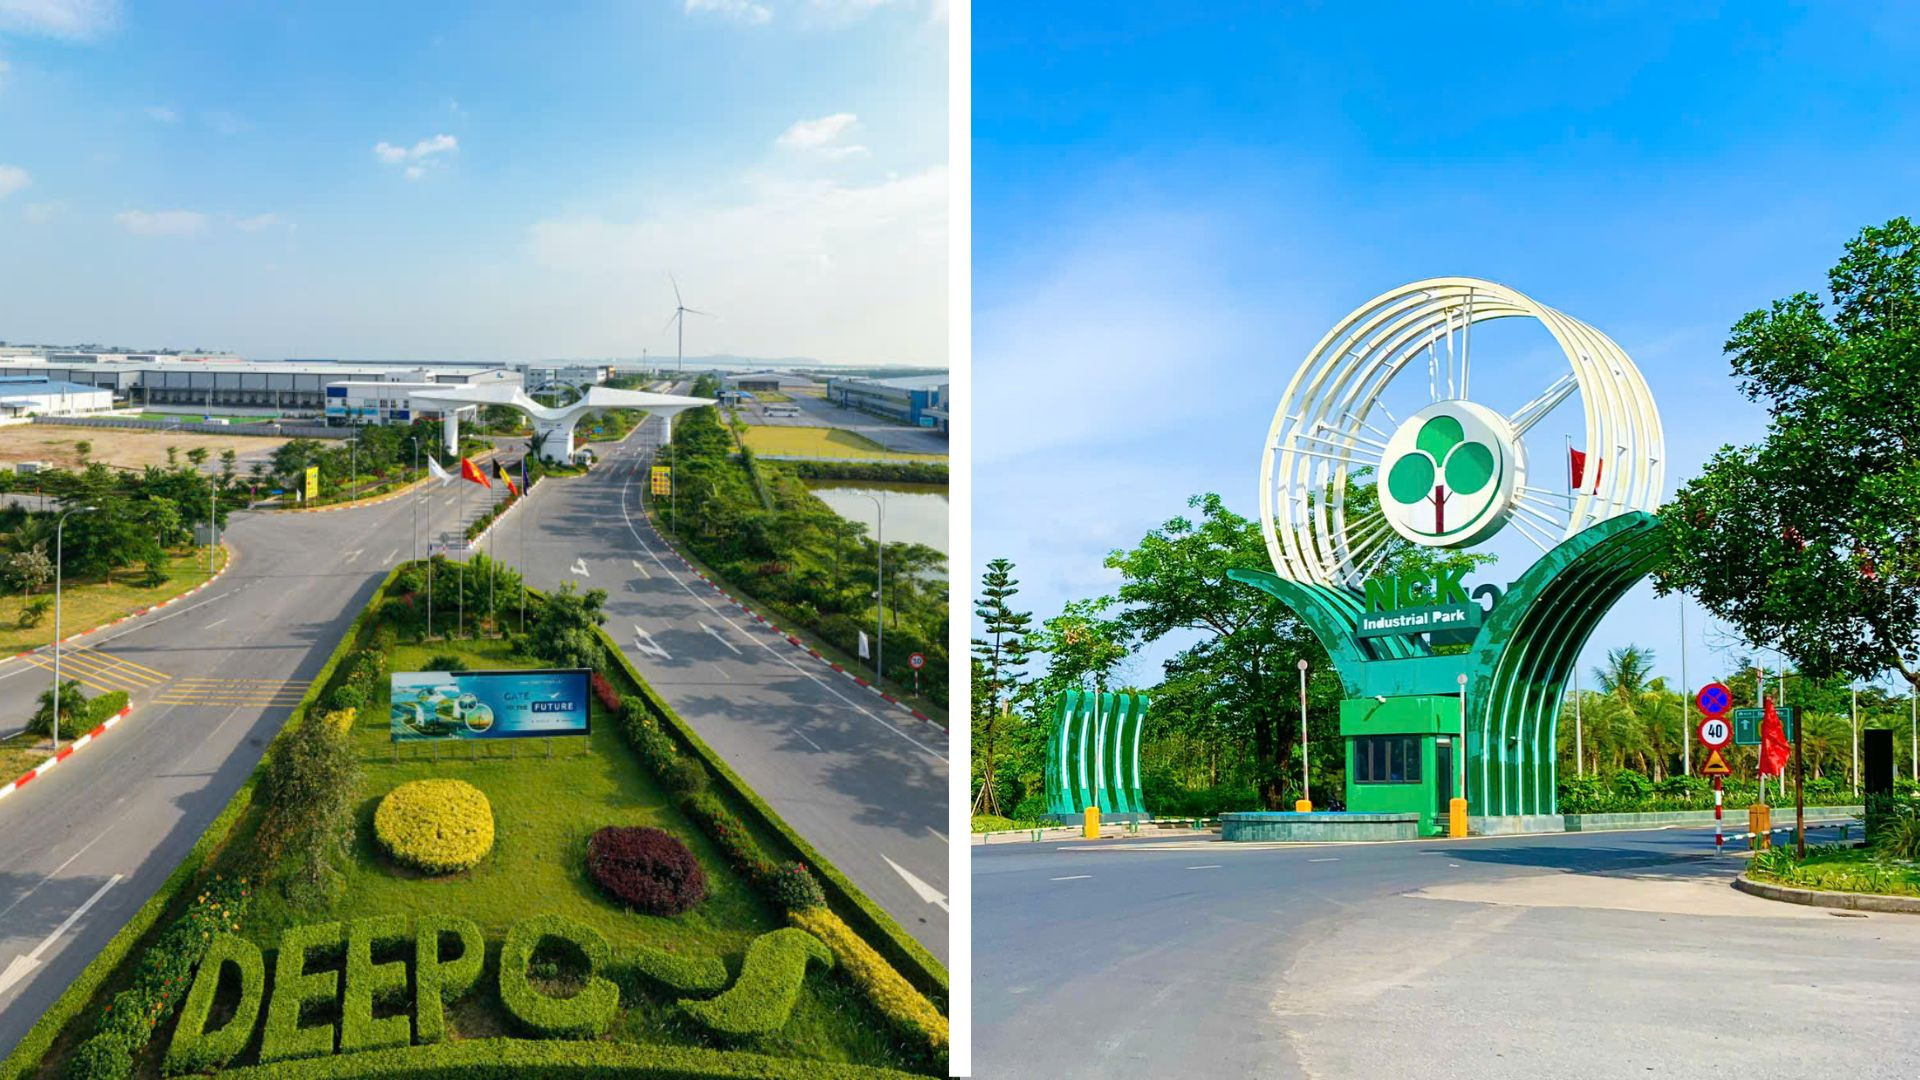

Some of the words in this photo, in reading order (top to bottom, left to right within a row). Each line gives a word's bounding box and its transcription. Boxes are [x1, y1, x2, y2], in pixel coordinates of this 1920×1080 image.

[1364, 564, 1471, 614] NCK
[1363, 613, 1428, 630] Industrial
[1432, 609, 1466, 624] Park
[504, 692, 529, 701] GATE
[534, 702, 574, 711] FUTURE
[1708, 724, 1723, 738] 40
